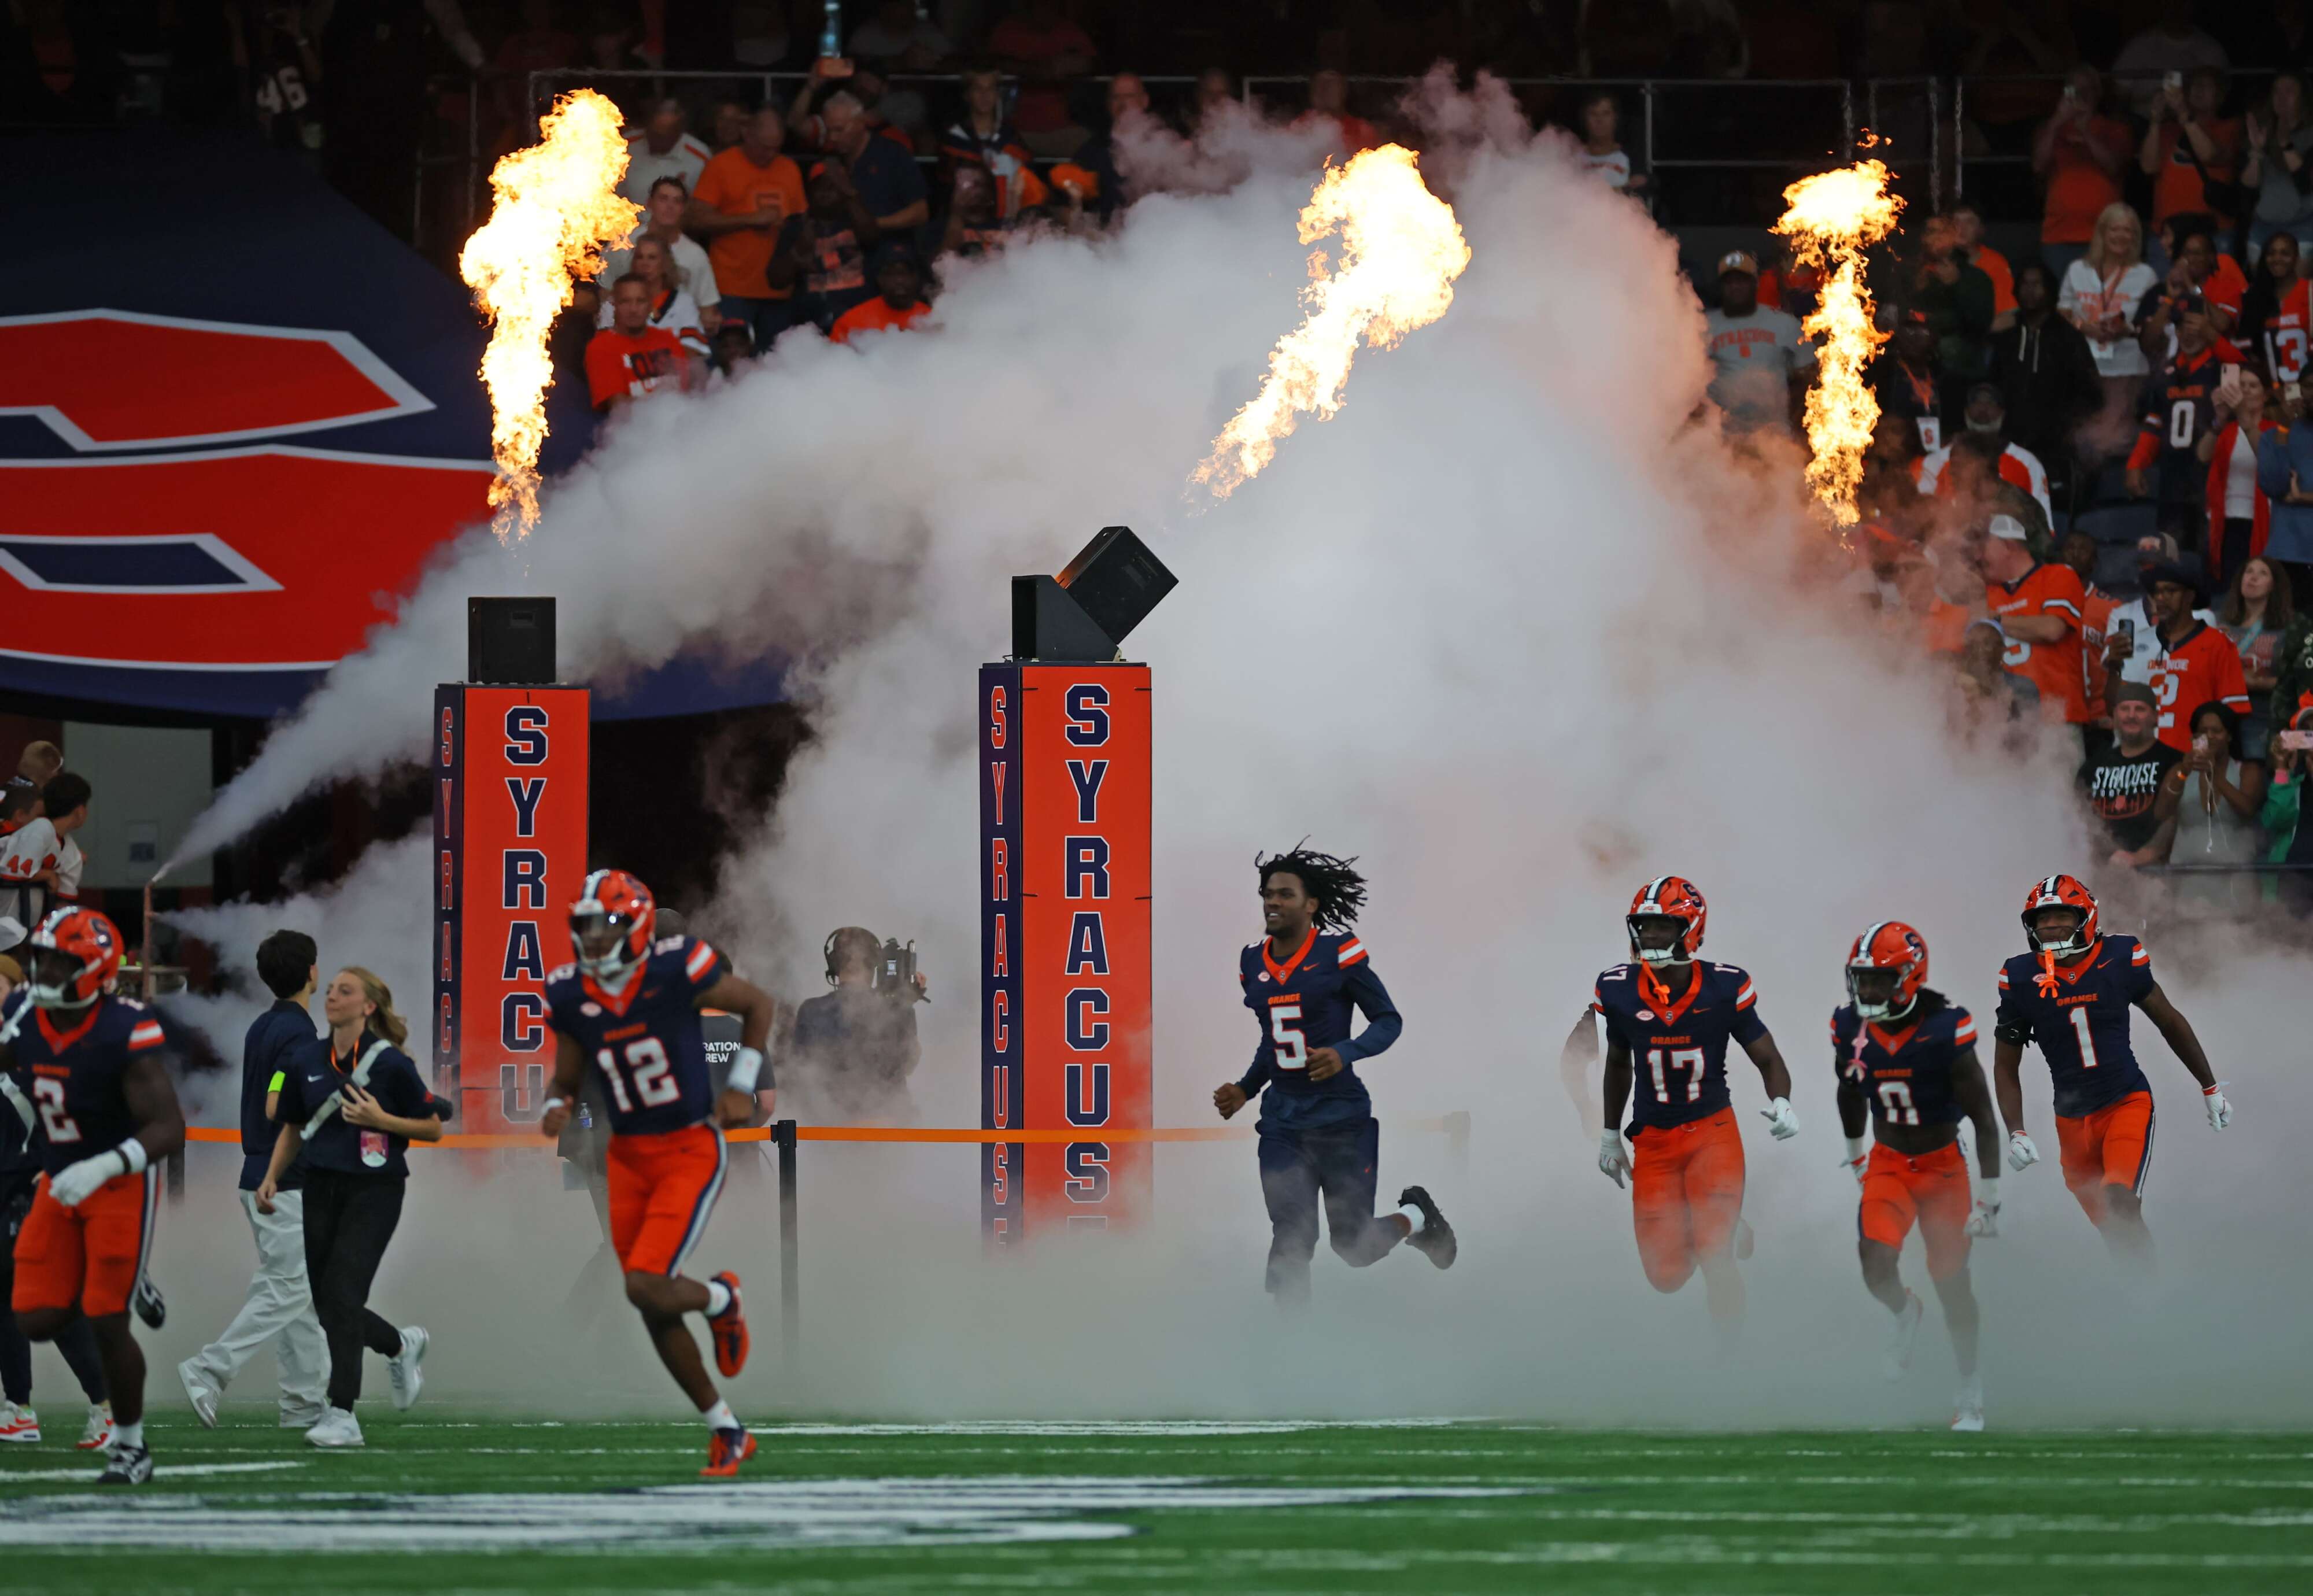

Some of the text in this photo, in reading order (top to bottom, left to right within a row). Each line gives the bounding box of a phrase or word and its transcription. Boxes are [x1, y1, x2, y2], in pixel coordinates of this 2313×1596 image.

[257, 65, 307, 114] 46
[2263, 328, 2308, 382] 13
[2170, 400, 2196, 449] 0
[2092, 762, 2160, 790] SYRACUSE
[7, 855, 33, 875] 44
[2068, 971, 2076, 981] S
[1268, 992, 1302, 1005] ORANGE
[2056, 993, 2098, 1007] ORANGE
[702, 1041, 741, 1052] RATION
[1271, 1006, 1309, 1070] 5
[1650, 1036, 1692, 1045] ORANGE
[2069, 1005, 2098, 1069] 1
[597, 1036, 681, 1113] 12
[705, 1052, 729, 1063] REW
[1647, 1046, 1705, 1104] 17
[33, 1076, 83, 1145] 2
